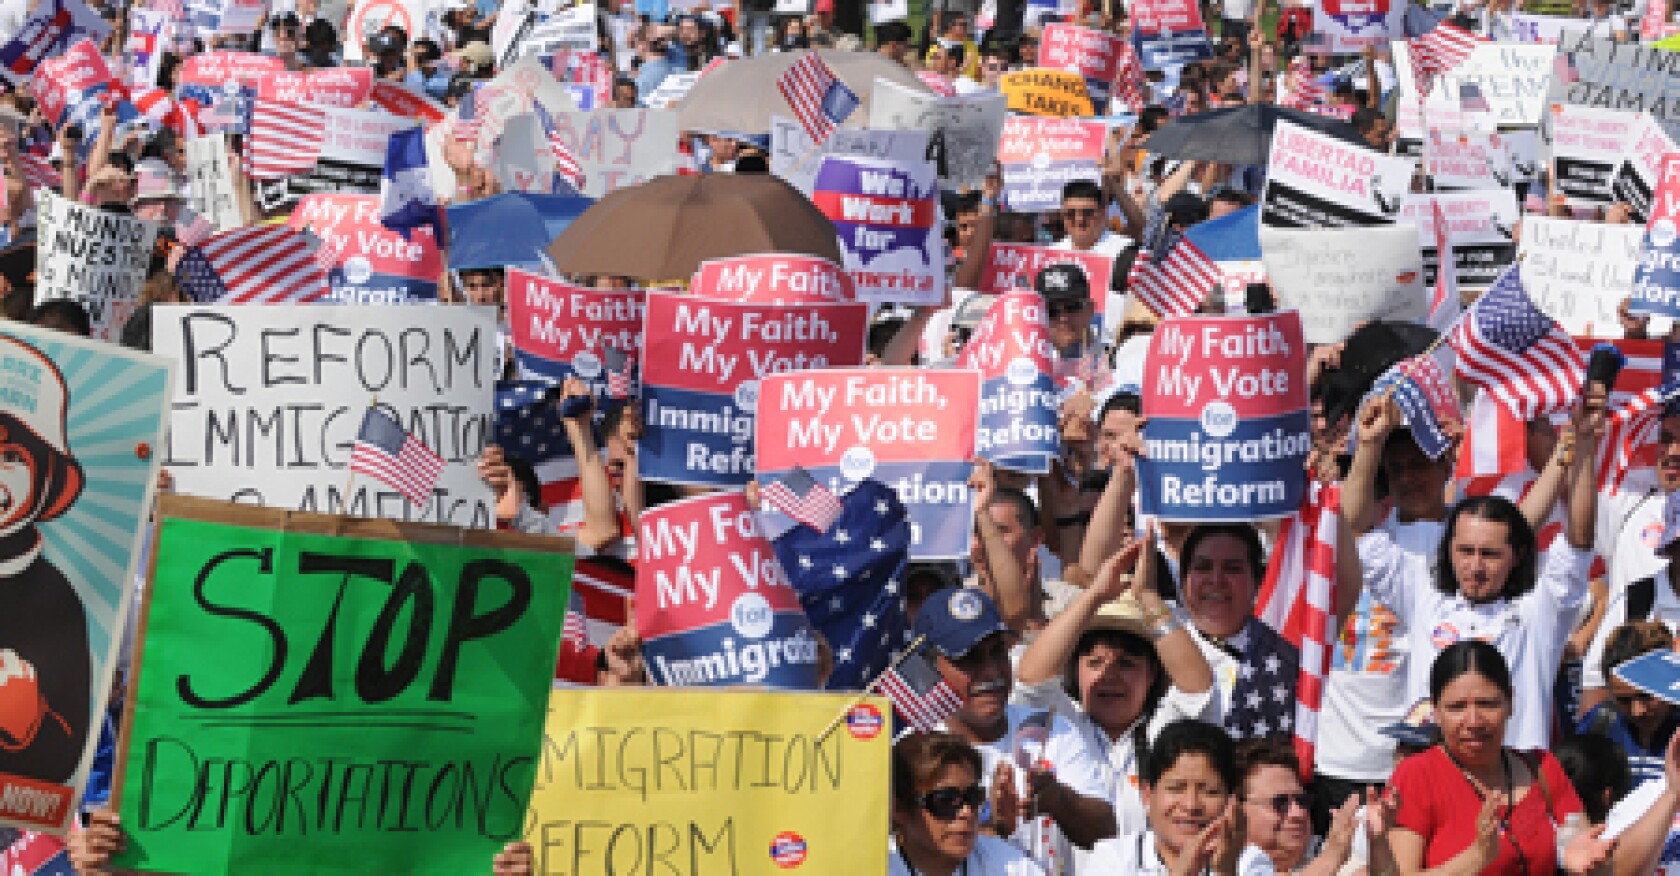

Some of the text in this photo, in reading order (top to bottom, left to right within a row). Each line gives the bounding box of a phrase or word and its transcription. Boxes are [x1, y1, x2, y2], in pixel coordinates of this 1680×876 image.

[302, 198, 350, 228] My
[841, 195, 914, 225] Work
[356, 229, 423, 263] Vote
[854, 226, 896, 251] for
[525, 281, 565, 316] My
[716, 264, 762, 302] My
[529, 312, 569, 352] My
[673, 303, 839, 345] My Faith,
[1157, 322, 1291, 366] My Faith,
[180, 309, 483, 396] REFORM
[678, 342, 829, 385] My Vote
[779, 376, 947, 415] My Faith,
[1155, 366, 1291, 406] My Vote
[786, 414, 938, 454] My Vote
[1161, 474, 1286, 506] Reform
[642, 517, 700, 569] My
[654, 567, 721, 610] My
[175, 547, 533, 710] STOP
[541, 724, 841, 804] MIGRATION
[137, 734, 537, 843] DEPORTATIONS
